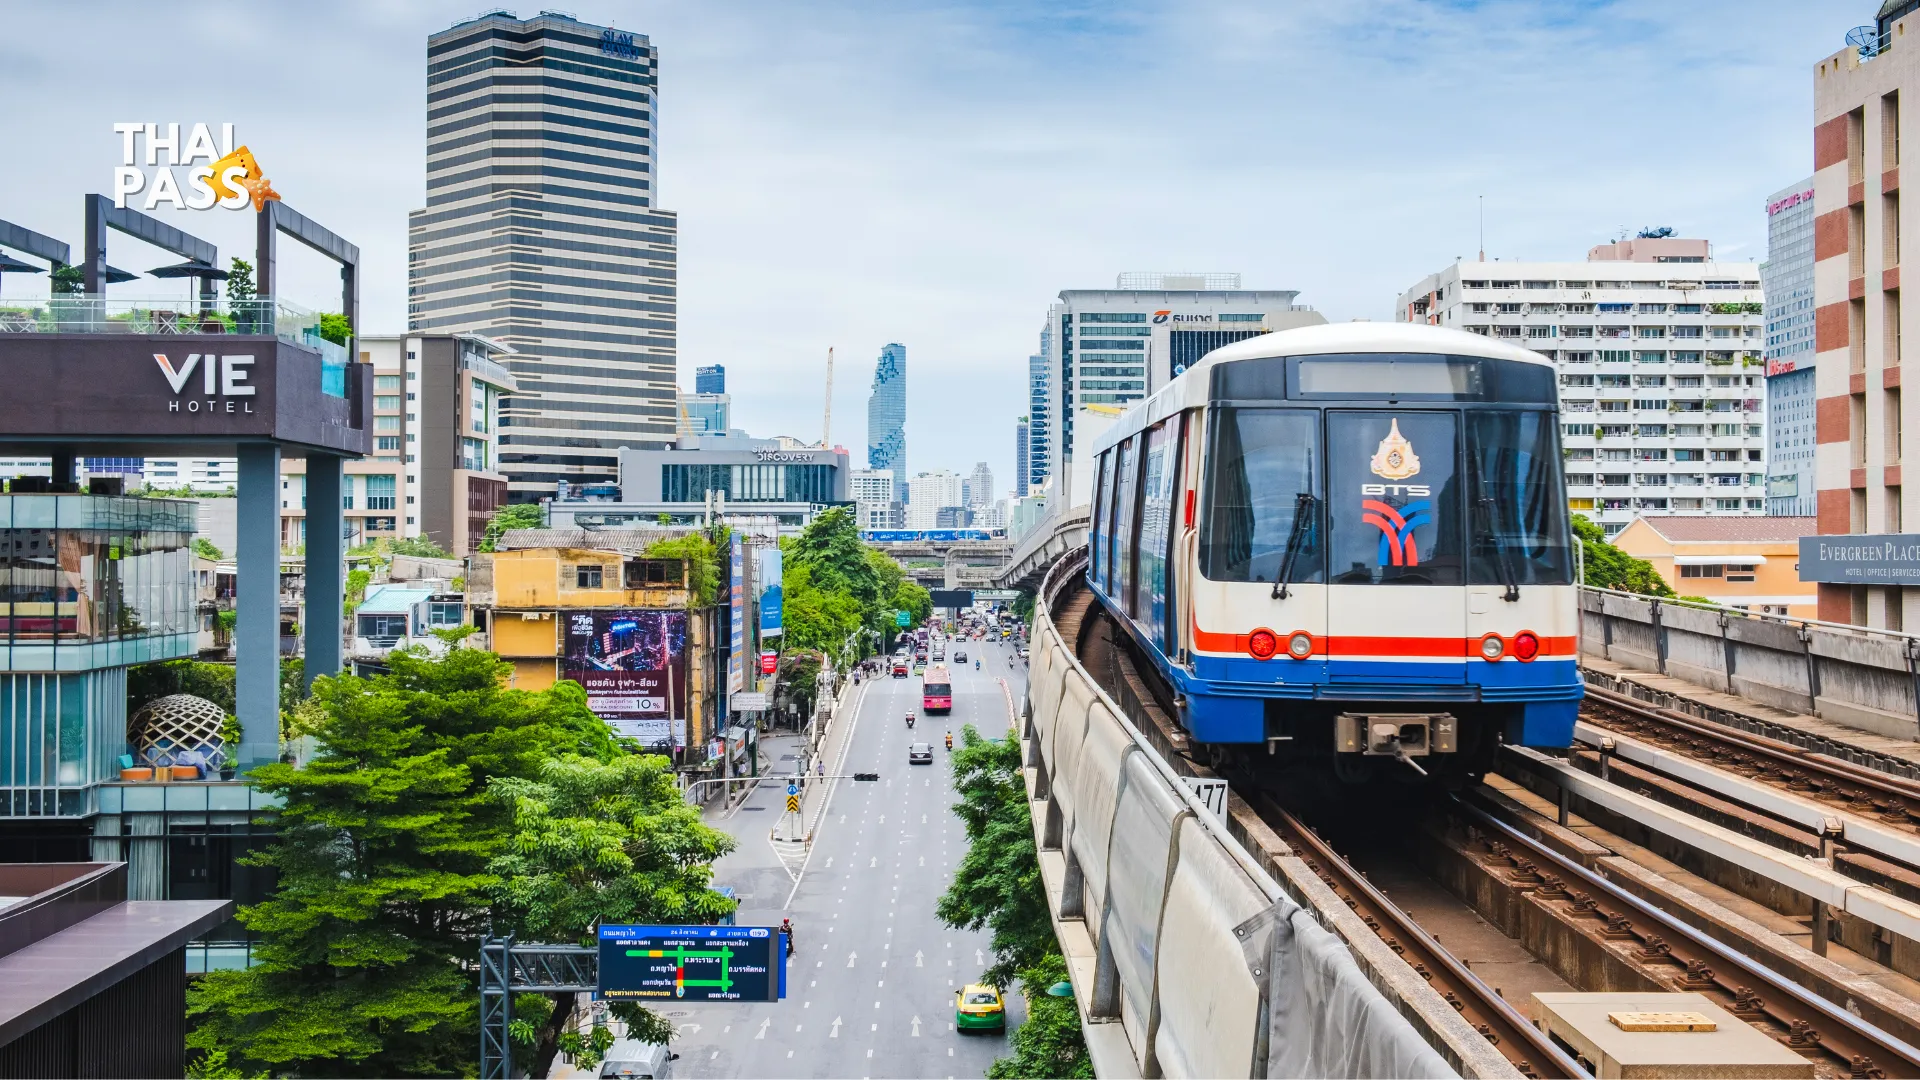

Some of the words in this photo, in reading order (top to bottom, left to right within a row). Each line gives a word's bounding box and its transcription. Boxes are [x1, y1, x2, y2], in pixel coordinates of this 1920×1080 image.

[603, 30, 633, 46] SIAM
[153, 353, 256, 396] VIE
[169, 400, 253, 413] HOTEL
[752, 445, 778, 454] SIAM
[757, 453, 815, 462] DISCOVERY
[1361, 483, 1431, 497] BTS
[1845, 568, 1863, 576] HOTEL
[1867, 568, 1887, 577] OFFICE
[586, 678, 615, 687] แอชตัน
[617, 677, 658, 689] จุฬา-สีลม
[636, 699, 651, 709] 10
[650, 963, 677, 973] ถ.พญาไท
